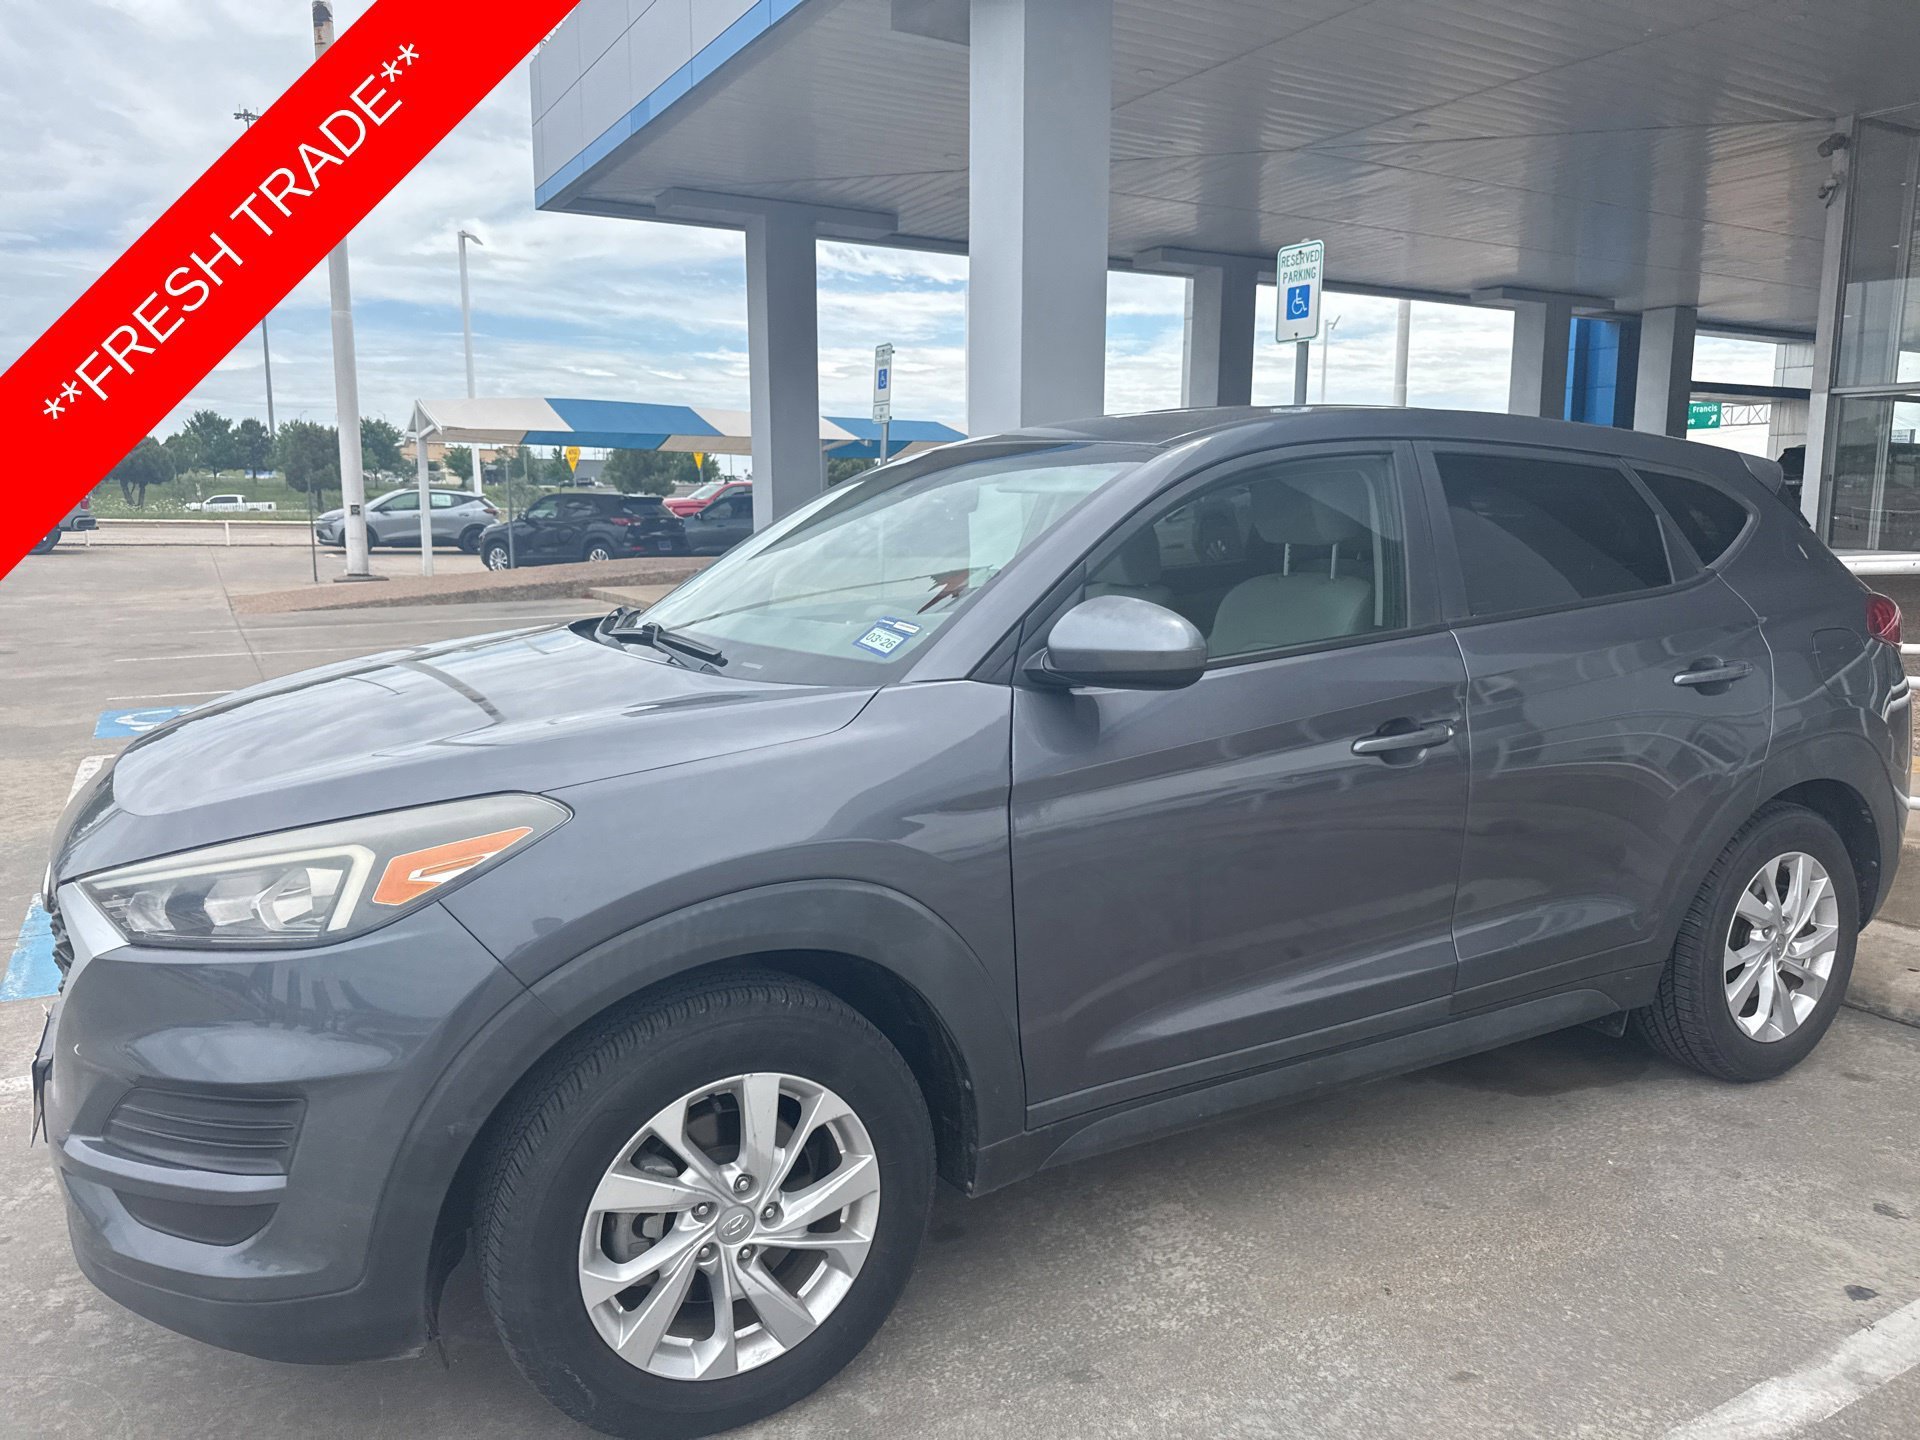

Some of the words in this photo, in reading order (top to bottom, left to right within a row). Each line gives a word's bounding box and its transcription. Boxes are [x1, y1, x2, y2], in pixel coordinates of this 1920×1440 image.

[1281, 249, 1319, 267] RESERVED
[1282, 267, 1316, 284] PARKING
[1692, 404, 1717, 413] Francis
